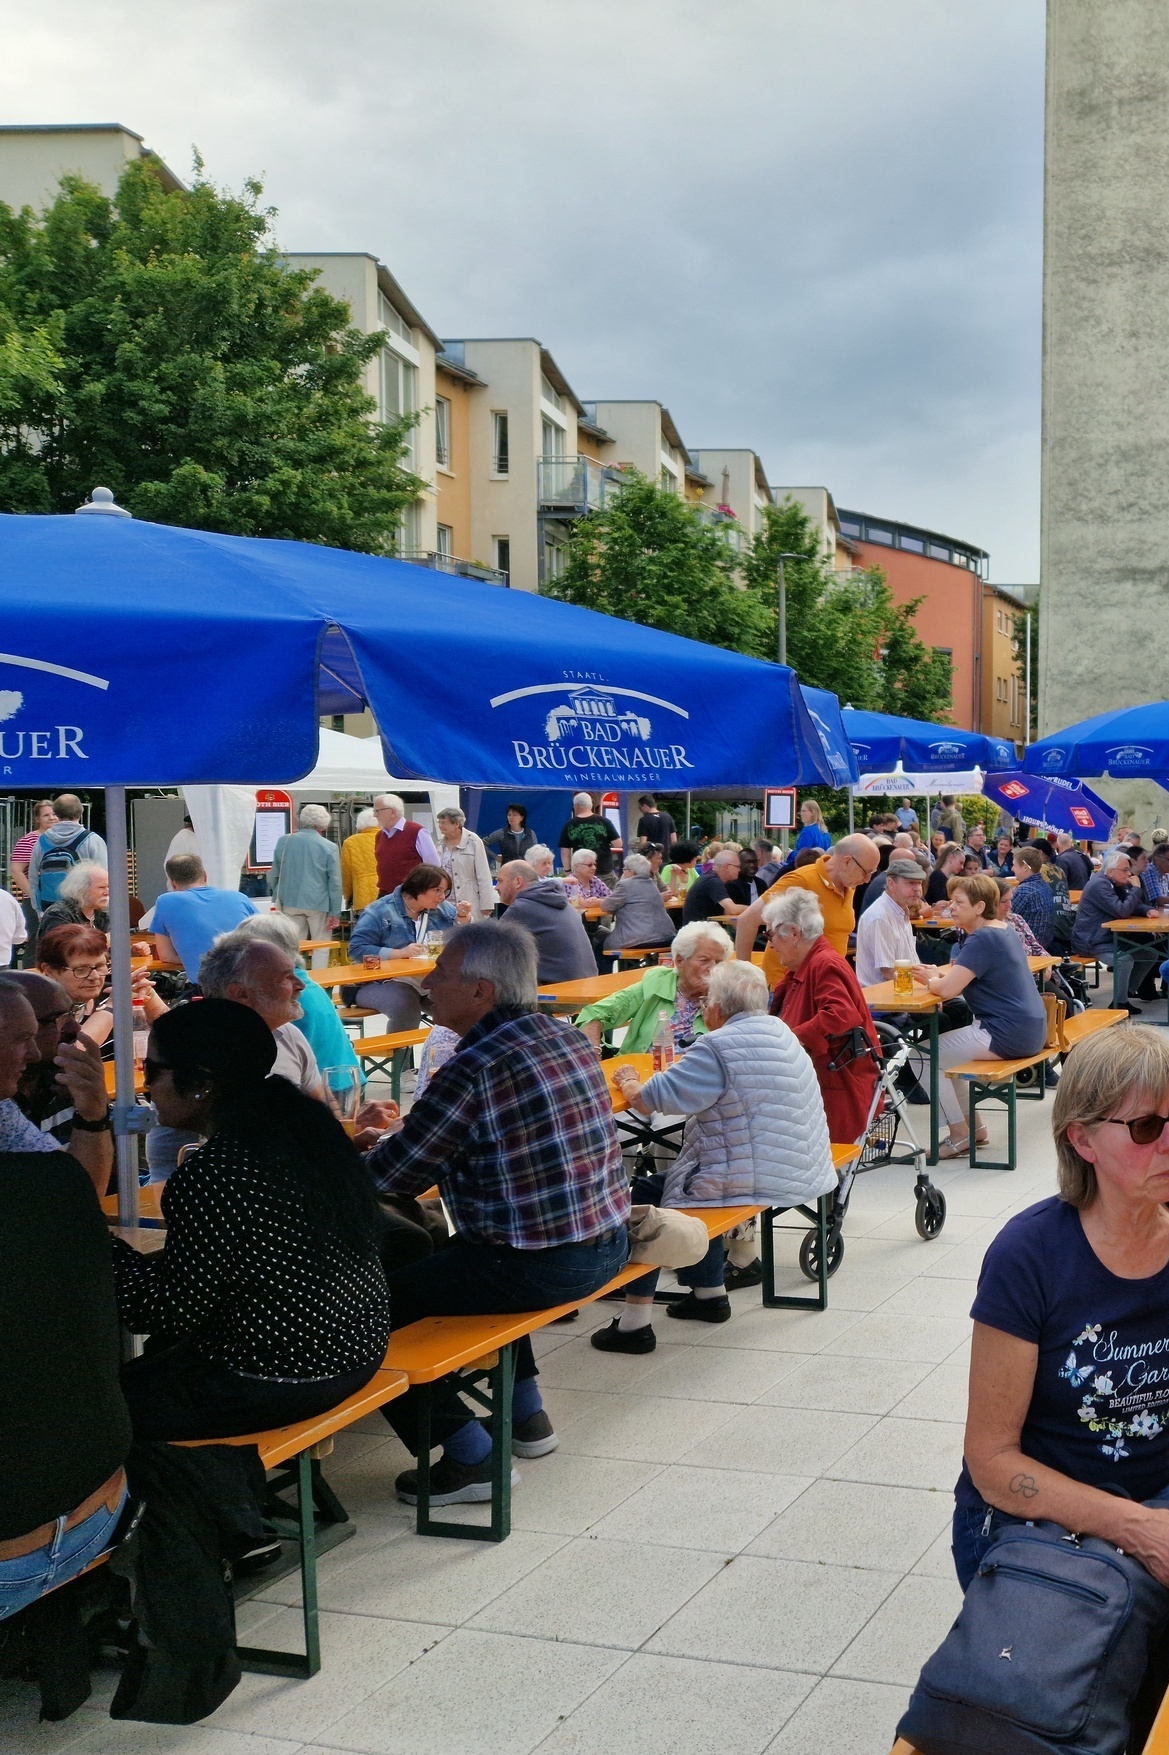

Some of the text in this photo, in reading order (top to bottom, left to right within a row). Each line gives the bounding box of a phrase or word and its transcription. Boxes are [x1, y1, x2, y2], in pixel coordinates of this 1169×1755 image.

[563, 670, 609, 681] STAATL.
[581, 721, 621, 743] BAD
[512, 740, 694, 769] BRÜCKENAUER
[564, 772, 661, 782] MINERALWASSER
[1108, 1391, 1153, 1409] BEAUTIFUL
